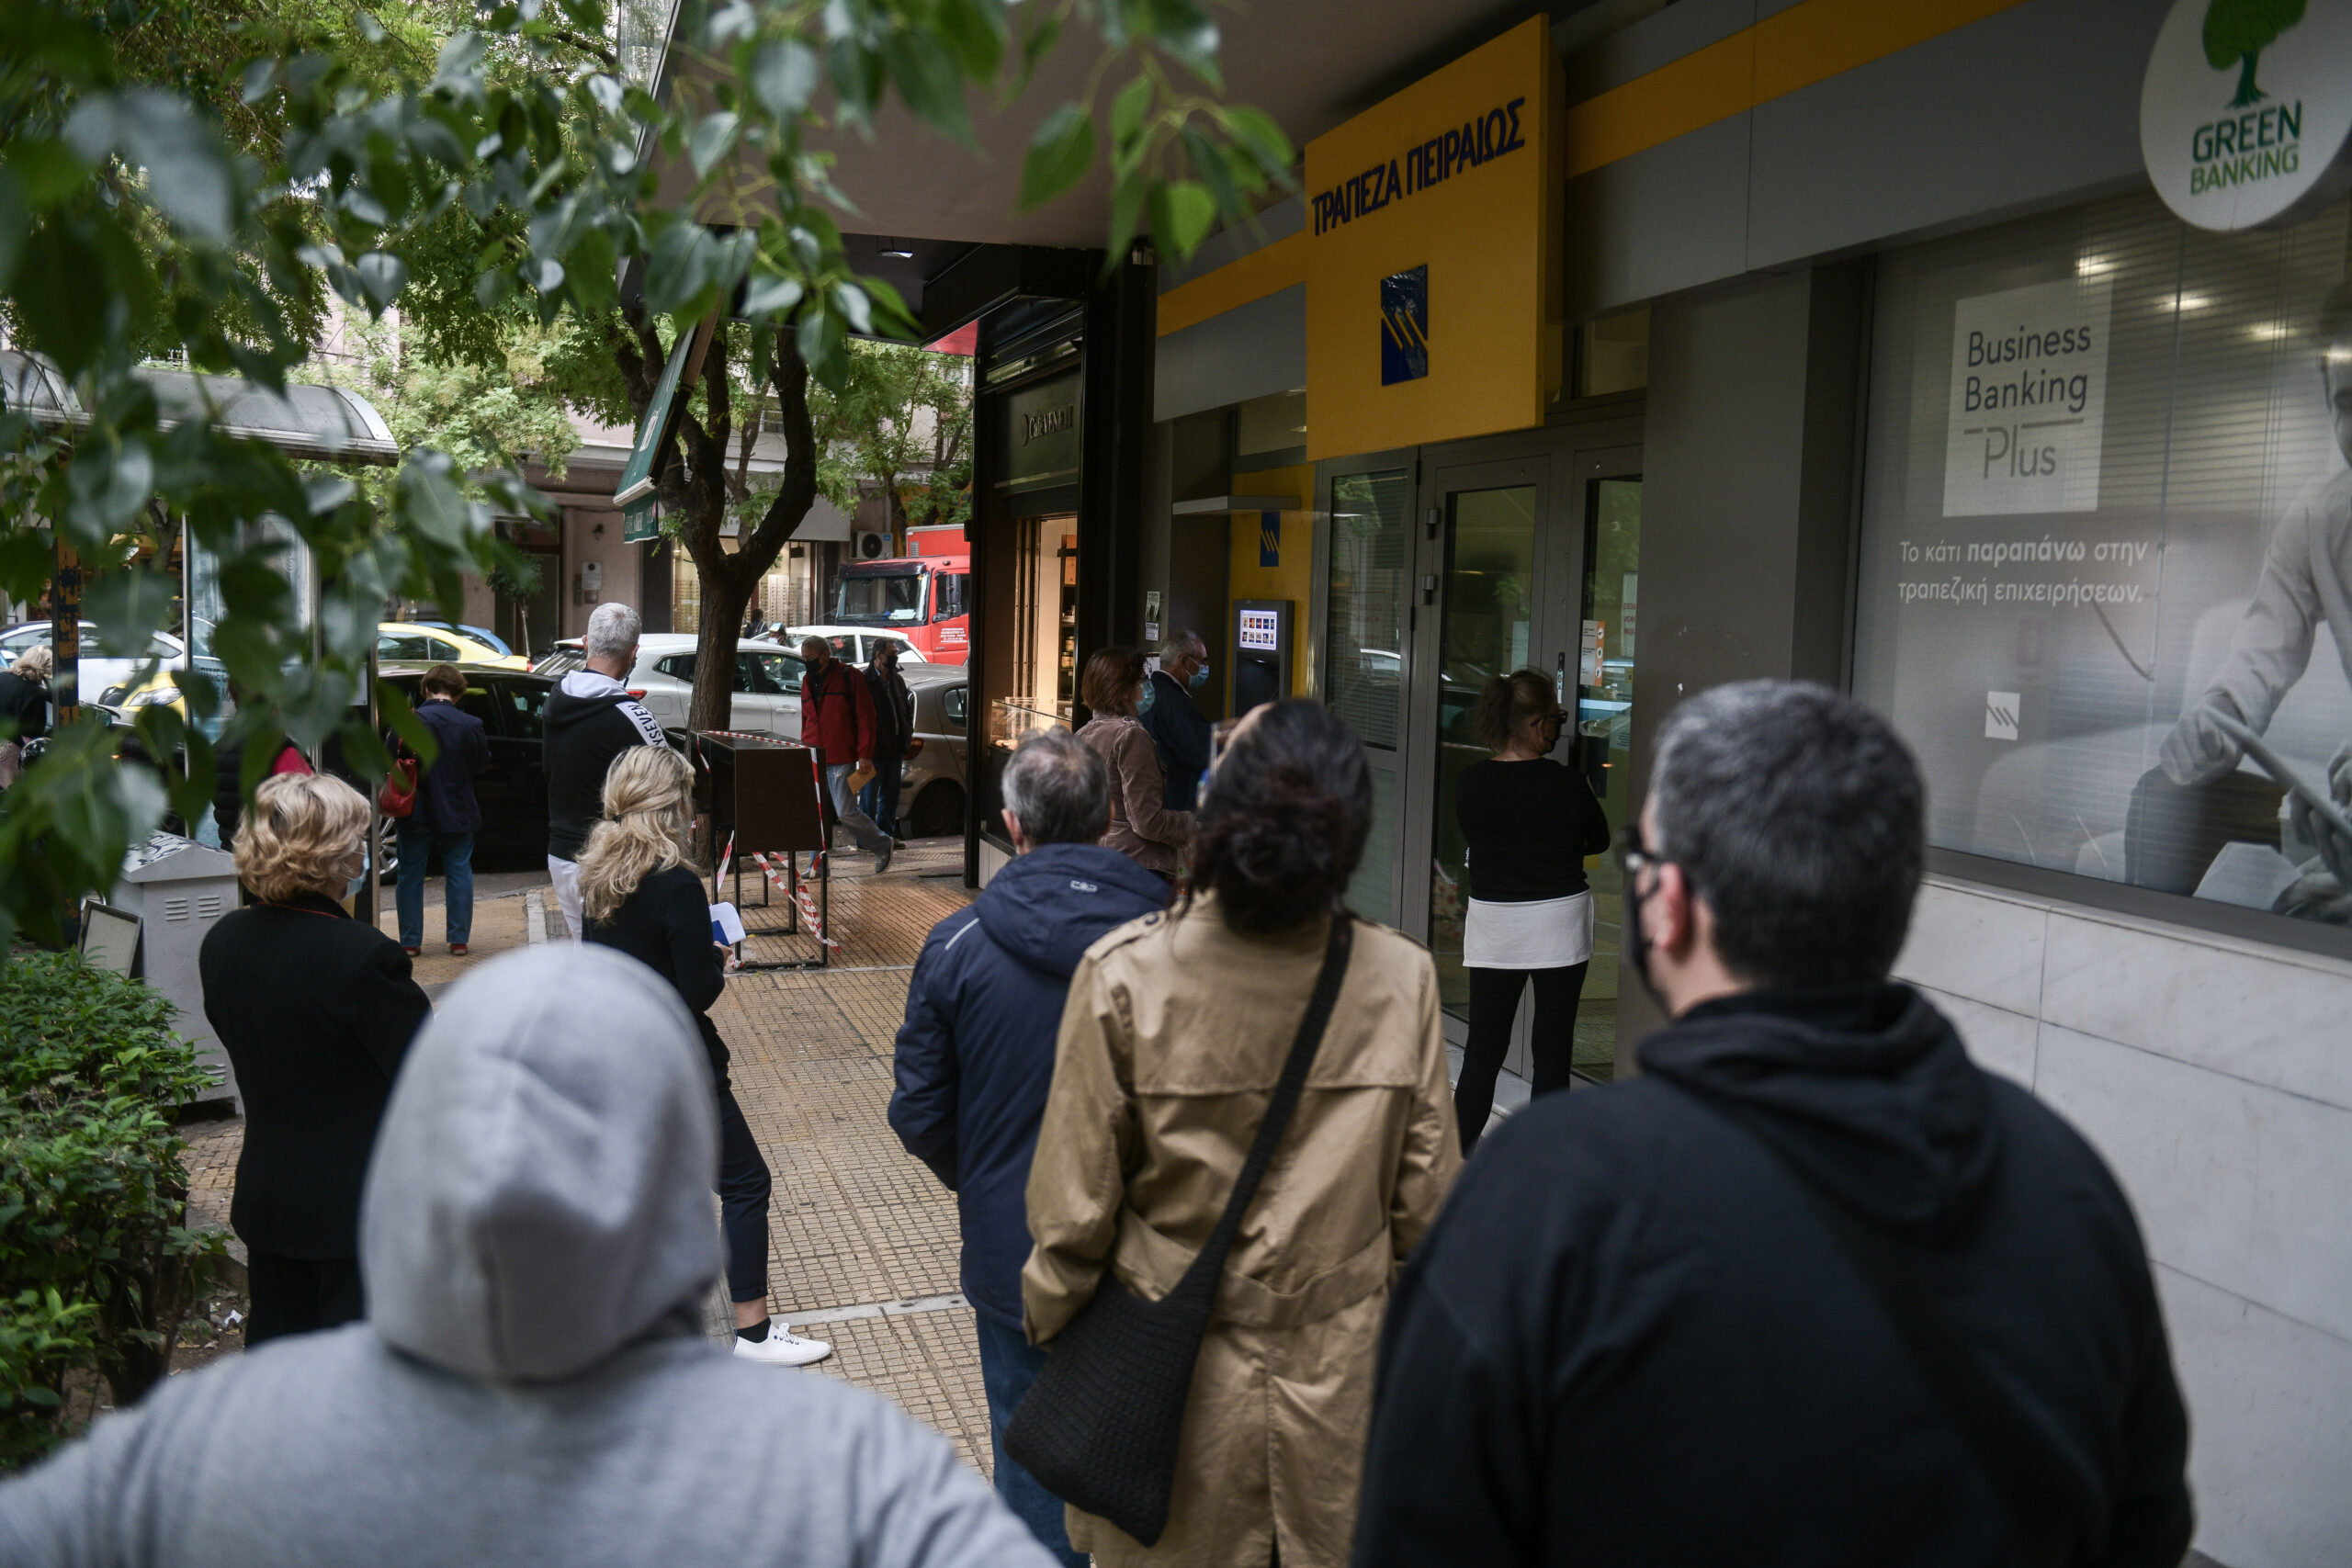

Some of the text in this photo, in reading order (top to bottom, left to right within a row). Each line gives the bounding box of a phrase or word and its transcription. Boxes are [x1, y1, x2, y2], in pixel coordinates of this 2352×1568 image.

[2192, 100, 2302, 164] GREEN
[1311, 96, 1525, 236] ΤΡΑΠΕΖΑ ΠΕΙΡΑΙΩΣ
[2190, 143, 2300, 196] BANKING
[1968, 325, 2091, 367] Business
[1964, 368, 2087, 413] Banking
[1984, 423, 2056, 479] Plus
[1900, 534, 2148, 568] Το κάτι παραπάνω στην
[1898, 576, 2143, 607] τραπεζική επιχειρήσεων.
